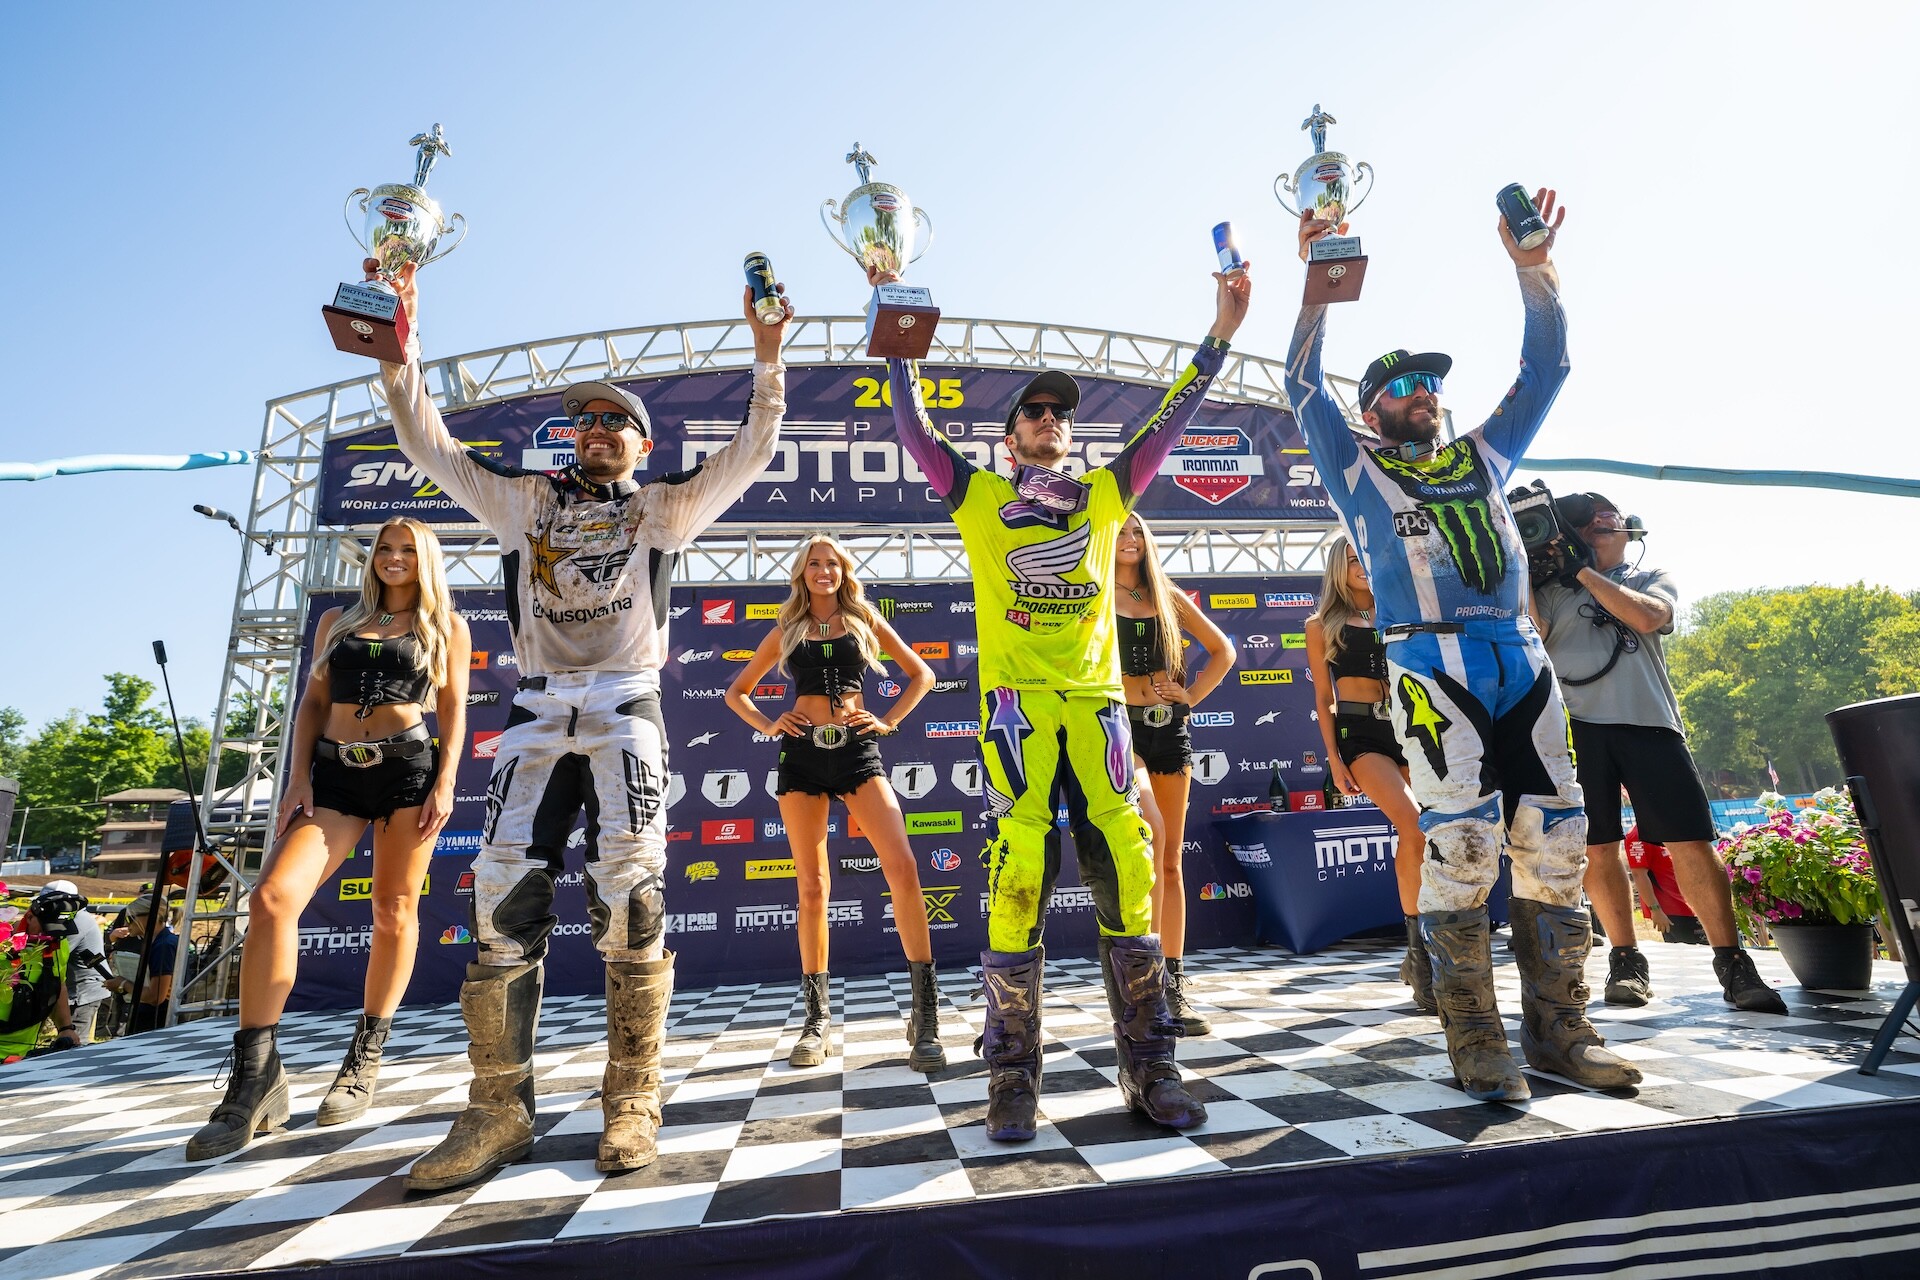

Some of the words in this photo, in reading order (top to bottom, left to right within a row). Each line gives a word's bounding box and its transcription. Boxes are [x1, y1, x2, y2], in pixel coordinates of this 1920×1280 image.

[341, 286, 396, 304] MOTOCROSS
[1150, 374, 1211, 434] HONDA
[1182, 459, 1239, 472] IRONMAN
[1433, 481, 1478, 496] YAMAHA
[341, 500, 389, 510] WORLD
[1290, 498, 1326, 508] WORLD
[1007, 578, 1101, 600] HONDA
[1216, 597, 1250, 605] Insta360
[1264, 593, 1312, 602] PARTS
[896, 601, 934, 609] MONSTER
[919, 646, 942, 655] KTM
[1241, 671, 1291, 682] SUZUKI
[683, 687, 726, 698] NAMUR
[756, 685, 786, 695] ETS
[1192, 712, 1234, 726] WPS
[926, 721, 979, 732] PARTS
[912, 818, 956, 829] Kawasaki
[686, 860, 716, 876] MOTO
[1226, 882, 1253, 899] NB
[686, 912, 718, 925] PRO
[551, 921, 592, 936] acoc
[686, 924, 718, 932] RACING
[298, 931, 374, 949] OTOCR
